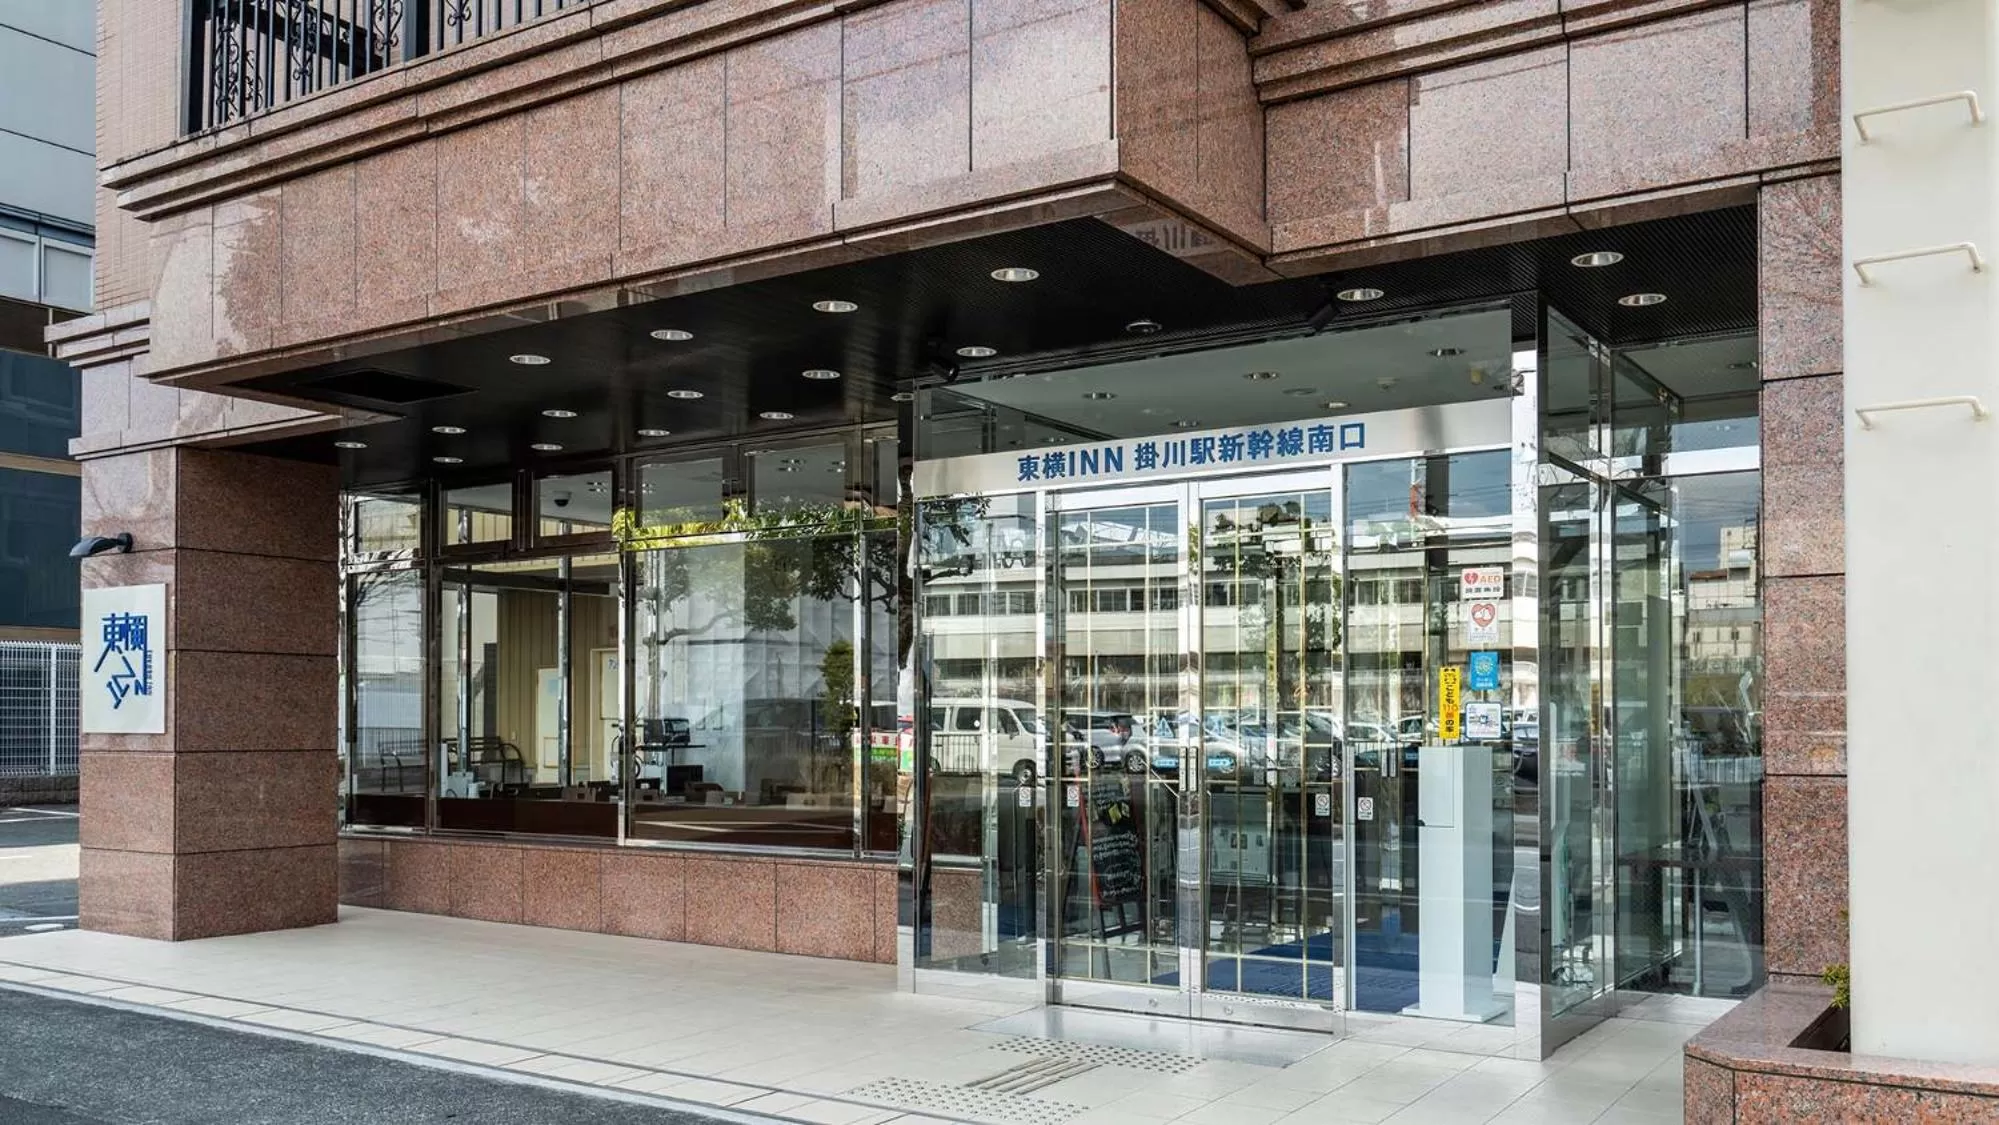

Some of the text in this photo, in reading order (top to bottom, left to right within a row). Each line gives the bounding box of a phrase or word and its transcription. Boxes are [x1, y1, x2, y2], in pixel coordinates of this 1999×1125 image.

[1017, 422, 1366, 482] 東横INN 掛川駅新幹線南口
[1479, 575, 1501, 584] AED
